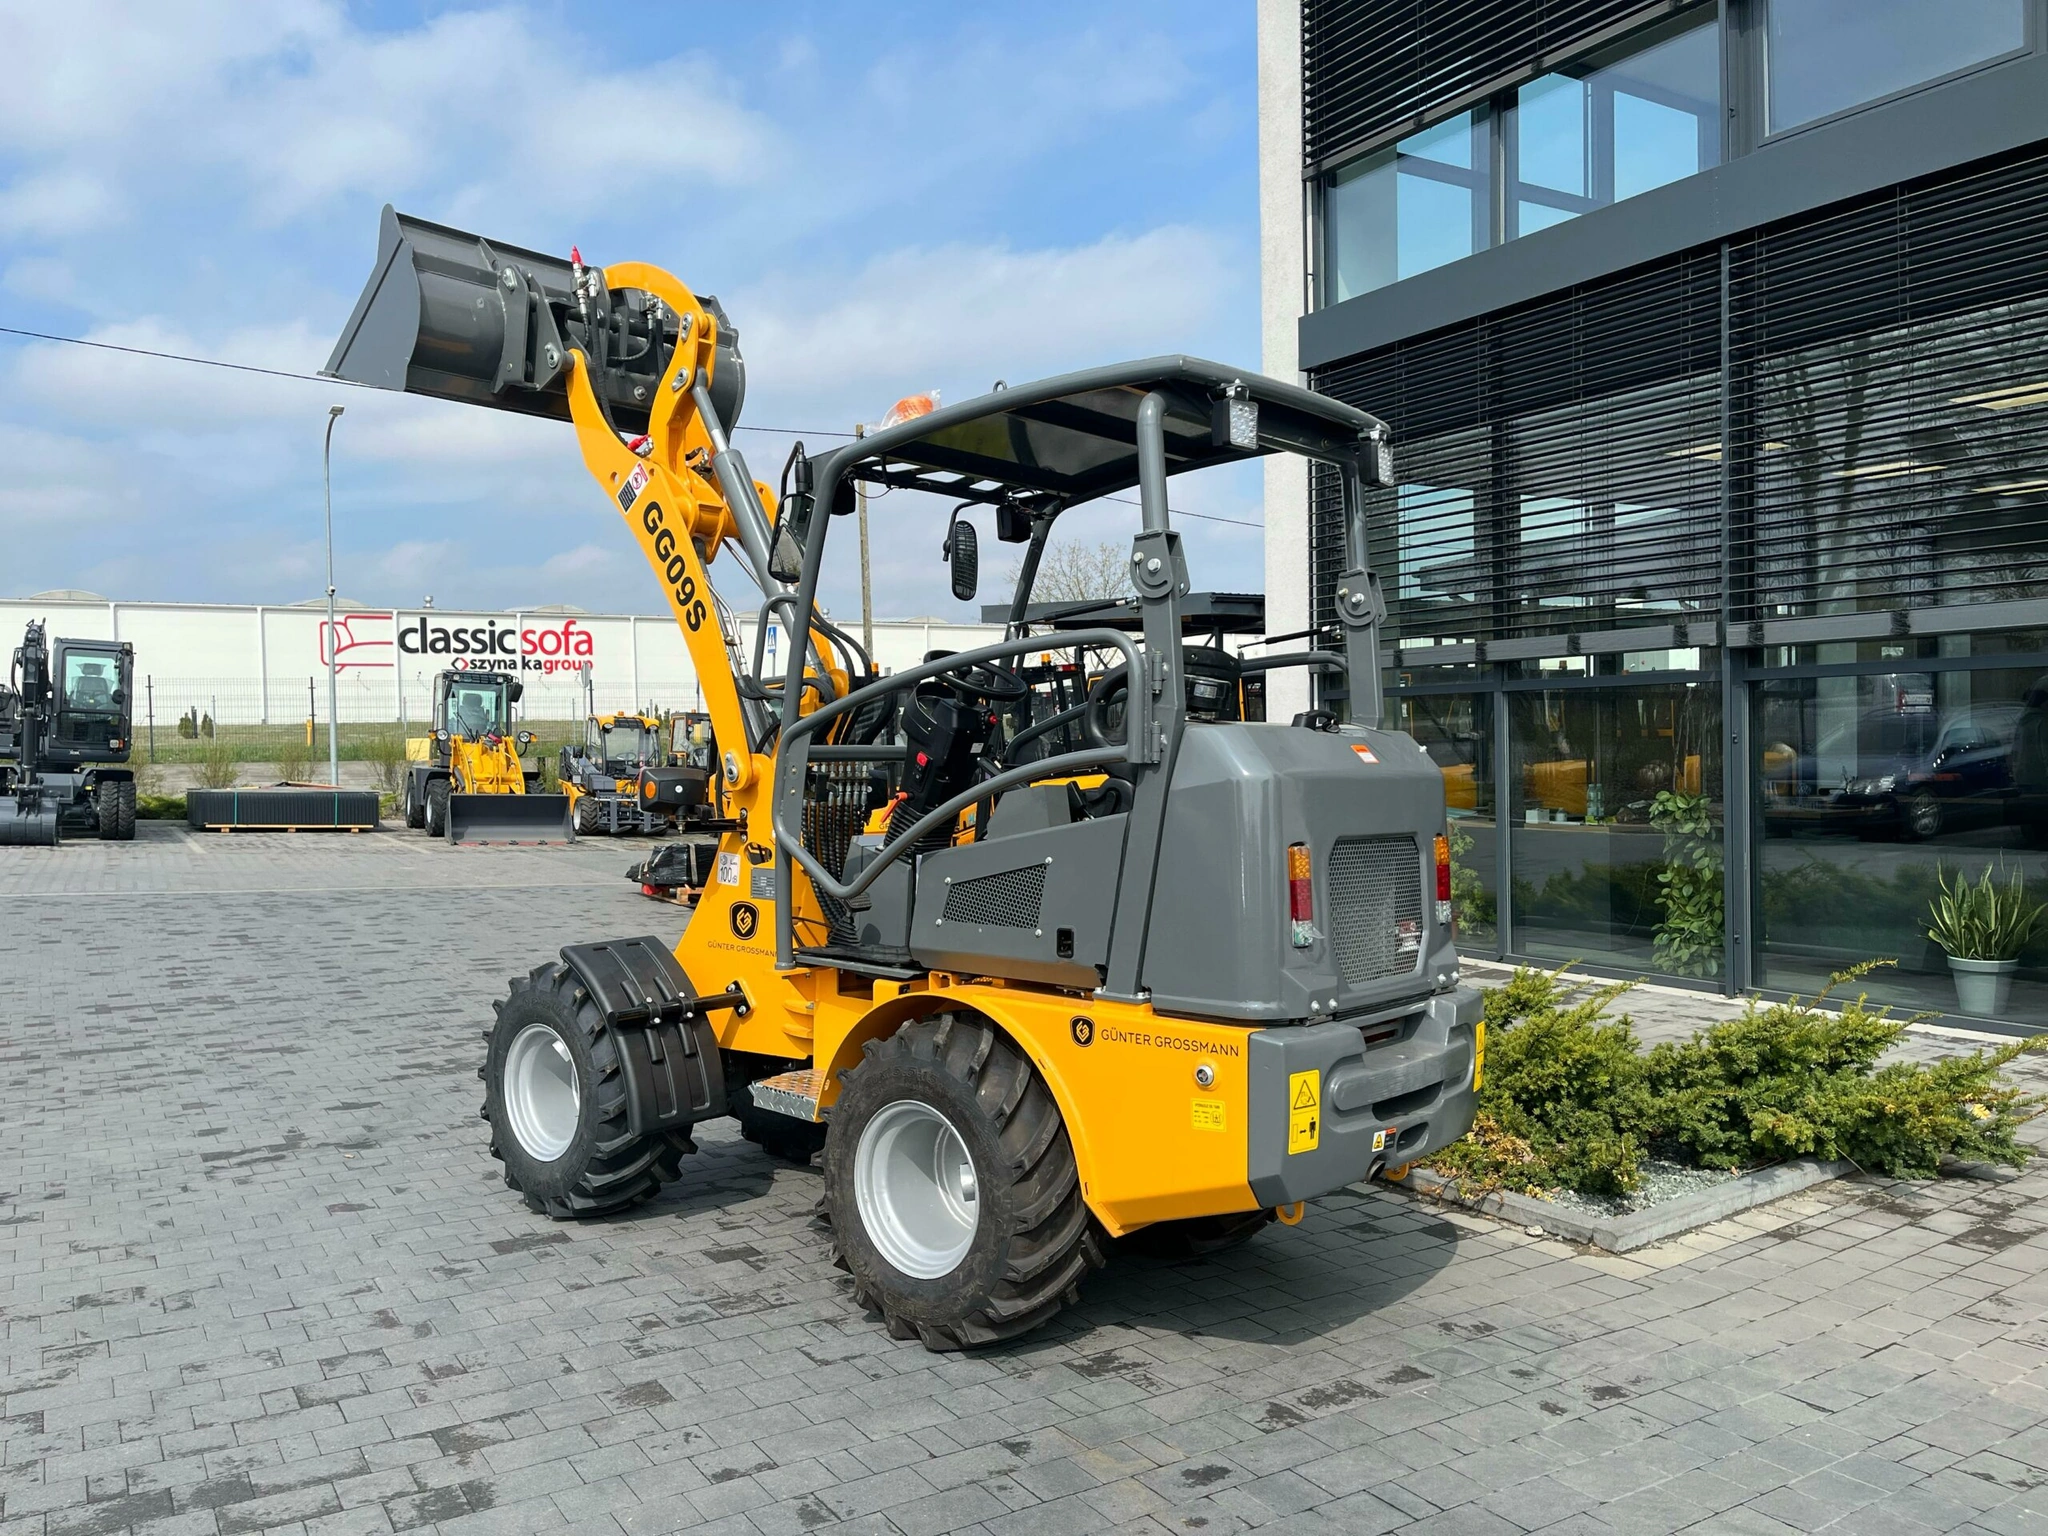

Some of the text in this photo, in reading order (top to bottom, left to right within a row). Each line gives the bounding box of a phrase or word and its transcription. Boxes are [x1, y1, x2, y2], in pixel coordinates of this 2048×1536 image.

[643, 501, 707, 632] GG09S
[708, 940, 777, 957] GÜNTER GROSSMAN
[1101, 1027, 1239, 1057] GÜNTER GROSSMANN
